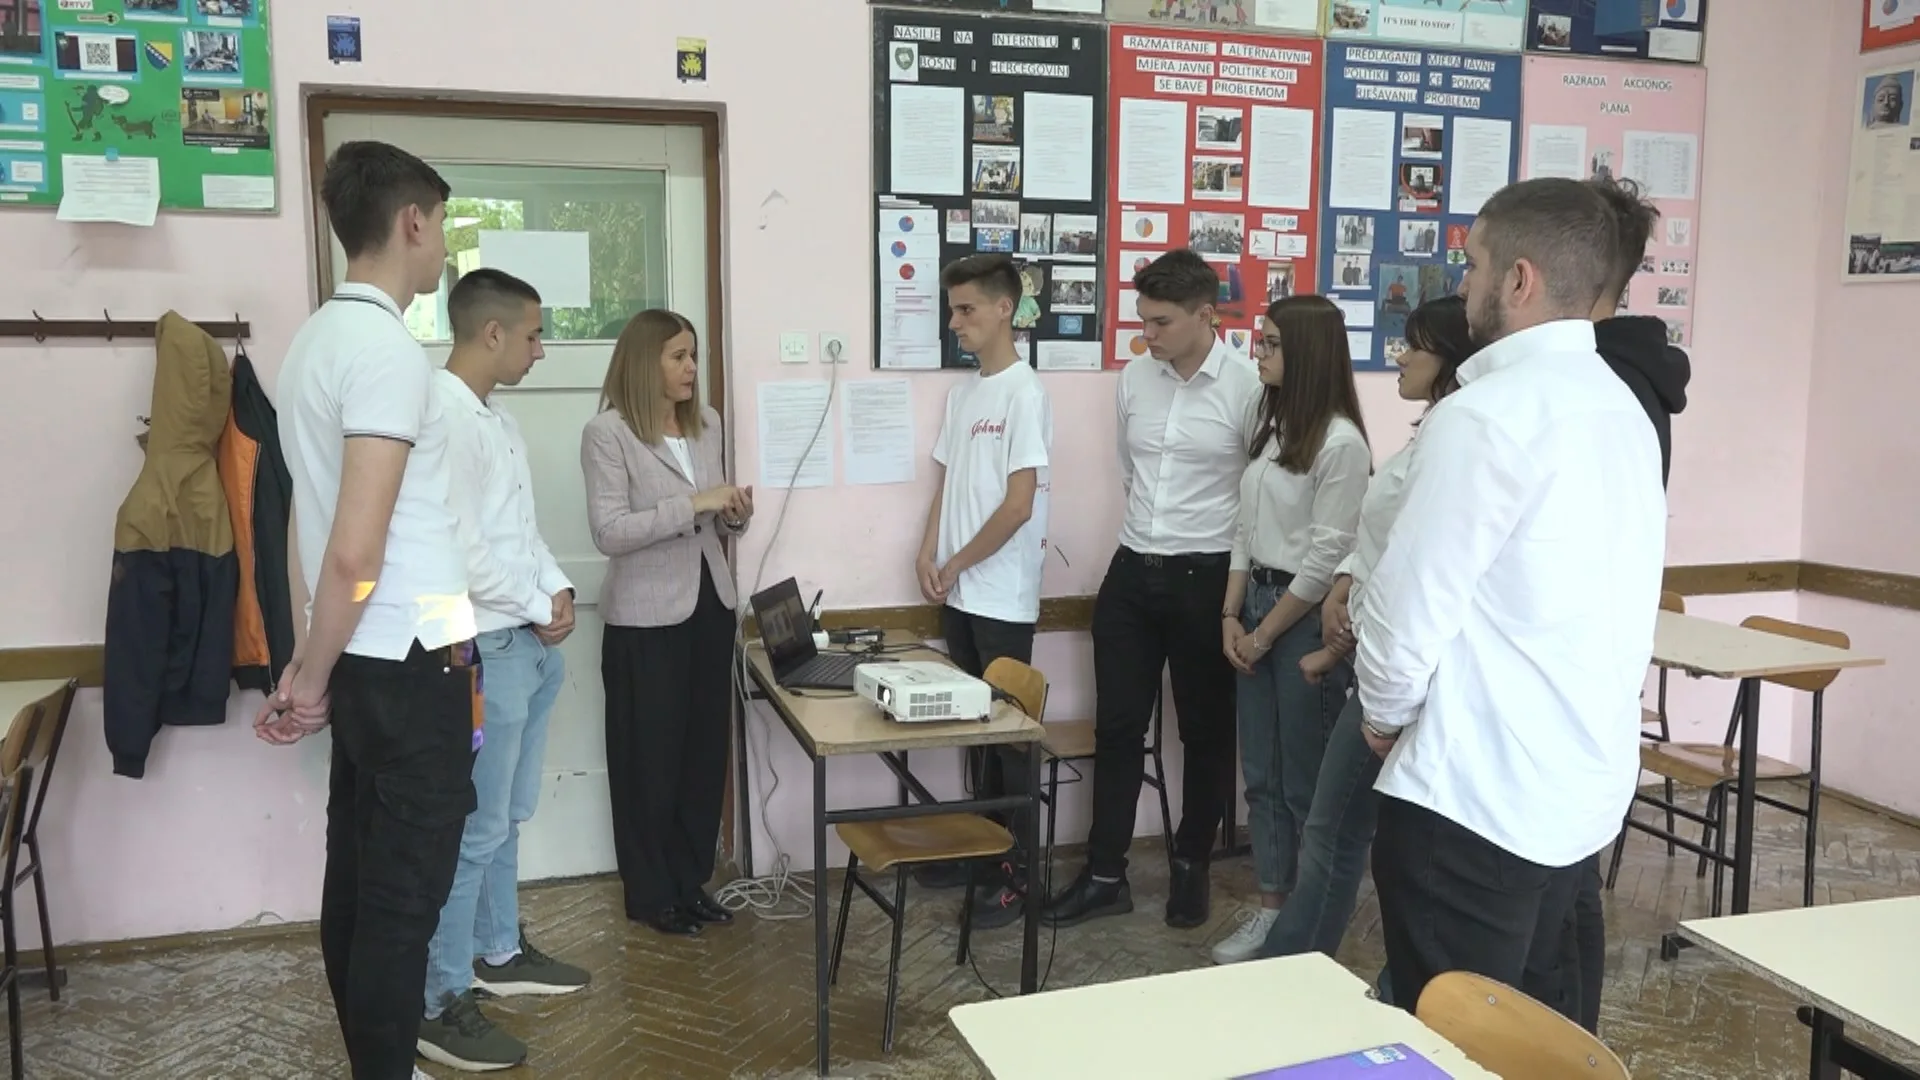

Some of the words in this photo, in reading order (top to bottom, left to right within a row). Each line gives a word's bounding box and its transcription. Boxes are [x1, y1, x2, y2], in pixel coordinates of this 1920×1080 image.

[1400, 17, 1417, 27] TIME
[1420, 19, 1431, 28] TO
[894, 26, 941, 41] NASILJE
[954, 31, 973, 44] NA
[993, 33, 1059, 48] INTERNETU
[1129, 37, 1210, 53] RAZMATRANJE
[1228, 44, 1311, 63] ALTERNATIVNIH
[1348, 48, 1419, 64] PREDLAGANJE
[990, 61, 1070, 78] HERCEGOVINI
[1138, 57, 1175, 72] MJERA
[1177, 60, 1213, 75] JAVNE
[1221, 64, 1268, 78] POLITIKE
[1270, 68, 1295, 81] KOJE
[1159, 79, 1172, 90] SE
[1175, 80, 1204, 92] BAVE
[1214, 83, 1285, 99] PROBLEMOM
[1562, 74, 1607, 87] RAZRADA
[1623, 78, 1673, 91] AKCIONOG
[1425, 92, 1480, 109] PROBLEMA
[1600, 102, 1631, 114] PLANA
